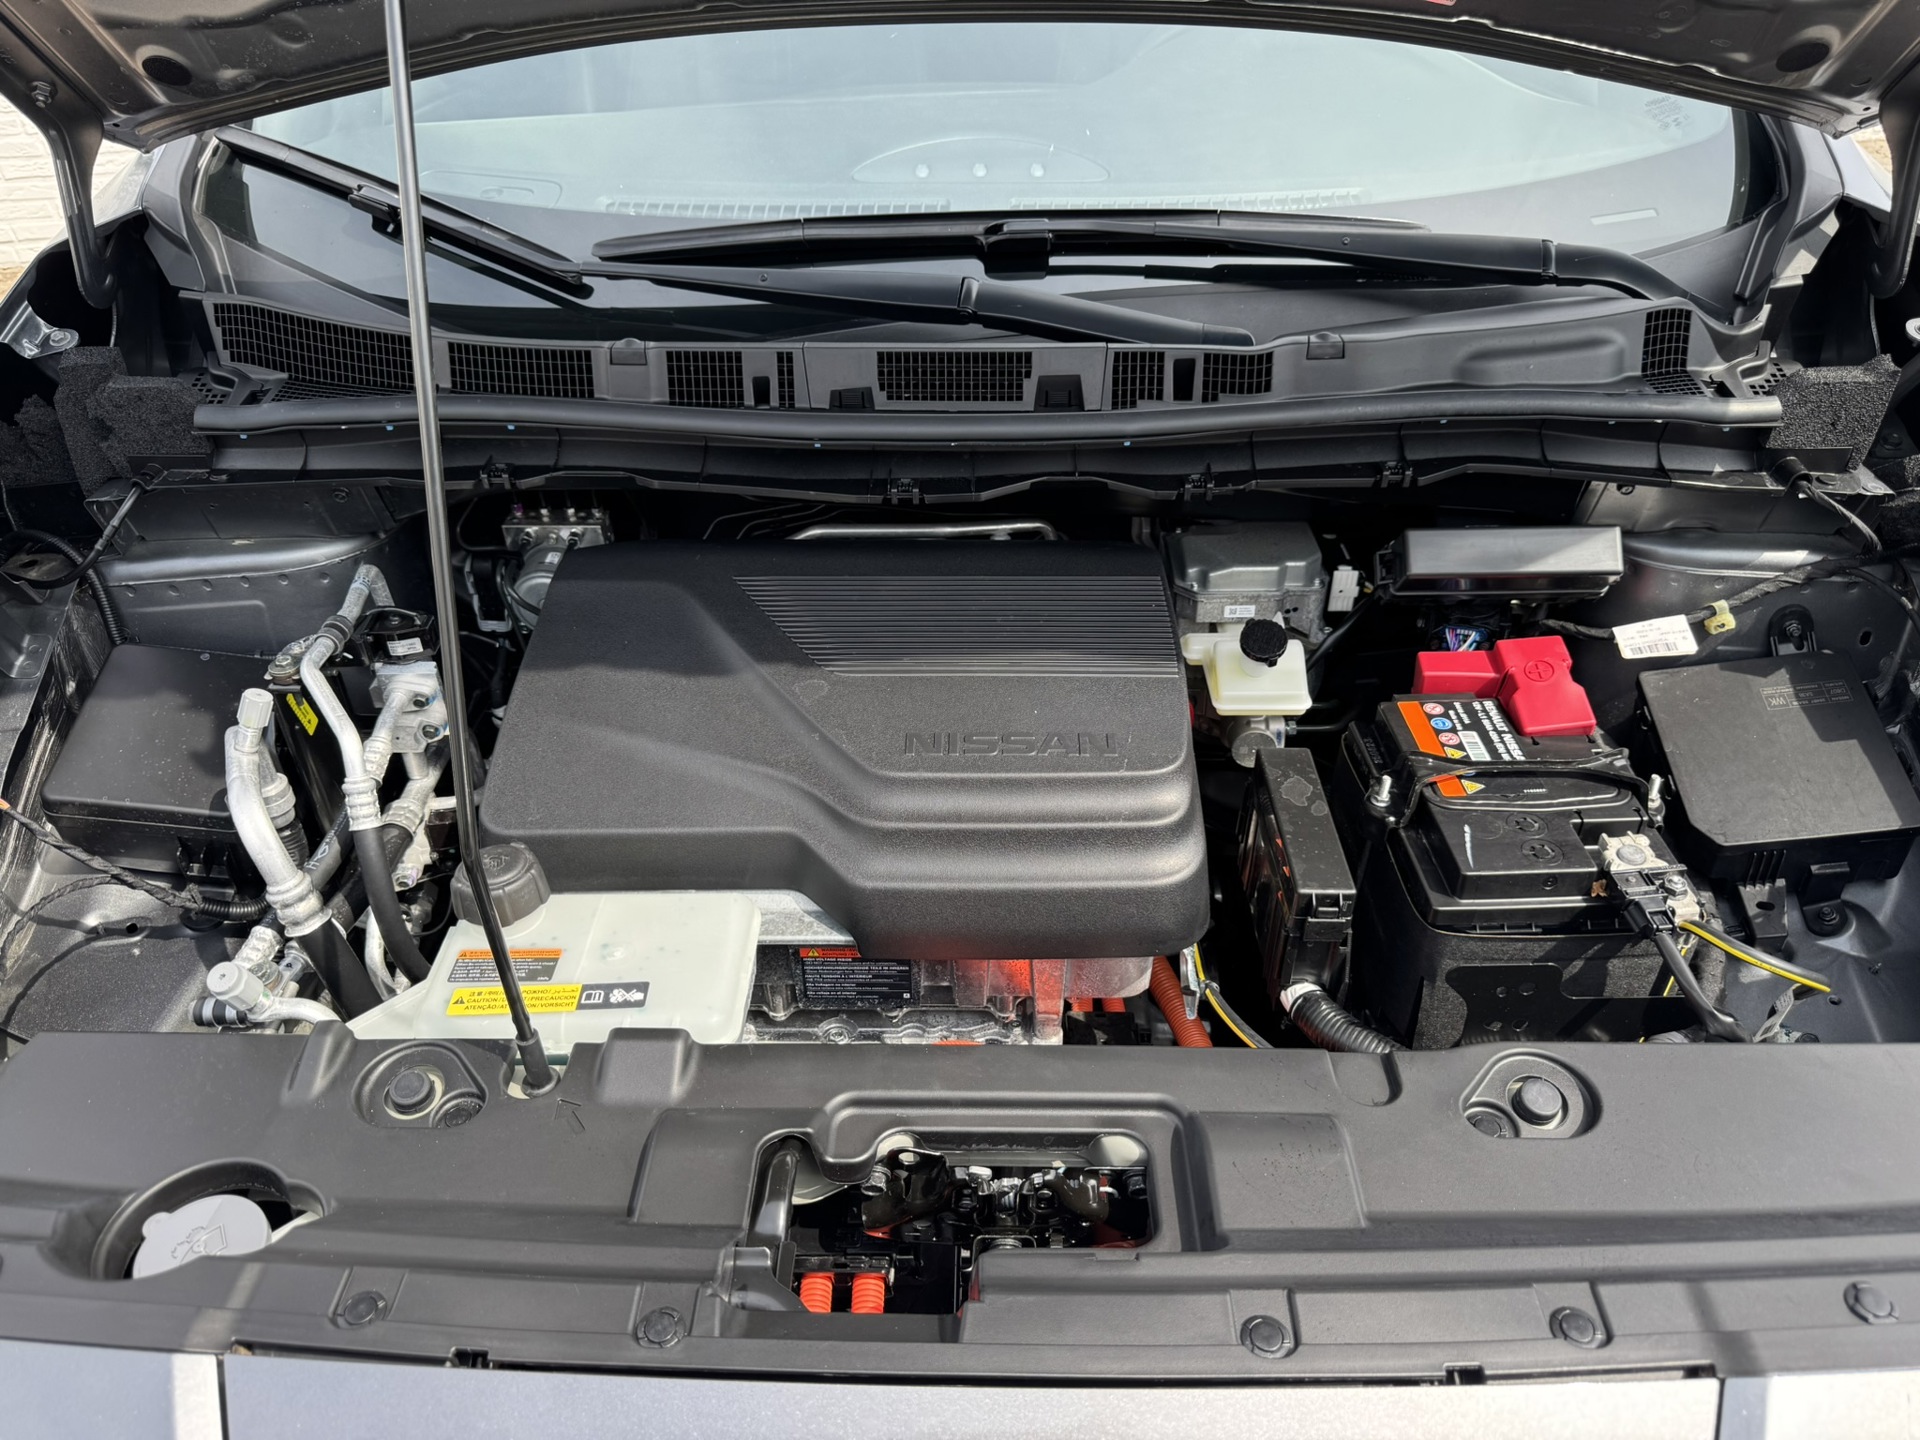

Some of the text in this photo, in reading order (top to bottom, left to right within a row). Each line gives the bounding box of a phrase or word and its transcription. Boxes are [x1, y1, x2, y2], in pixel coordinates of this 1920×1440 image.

[1768, 697, 1786, 706] WK
[1482, 701, 1526, 760] RENAULT NISSA
[904, 732, 1118, 757] NISSAN
